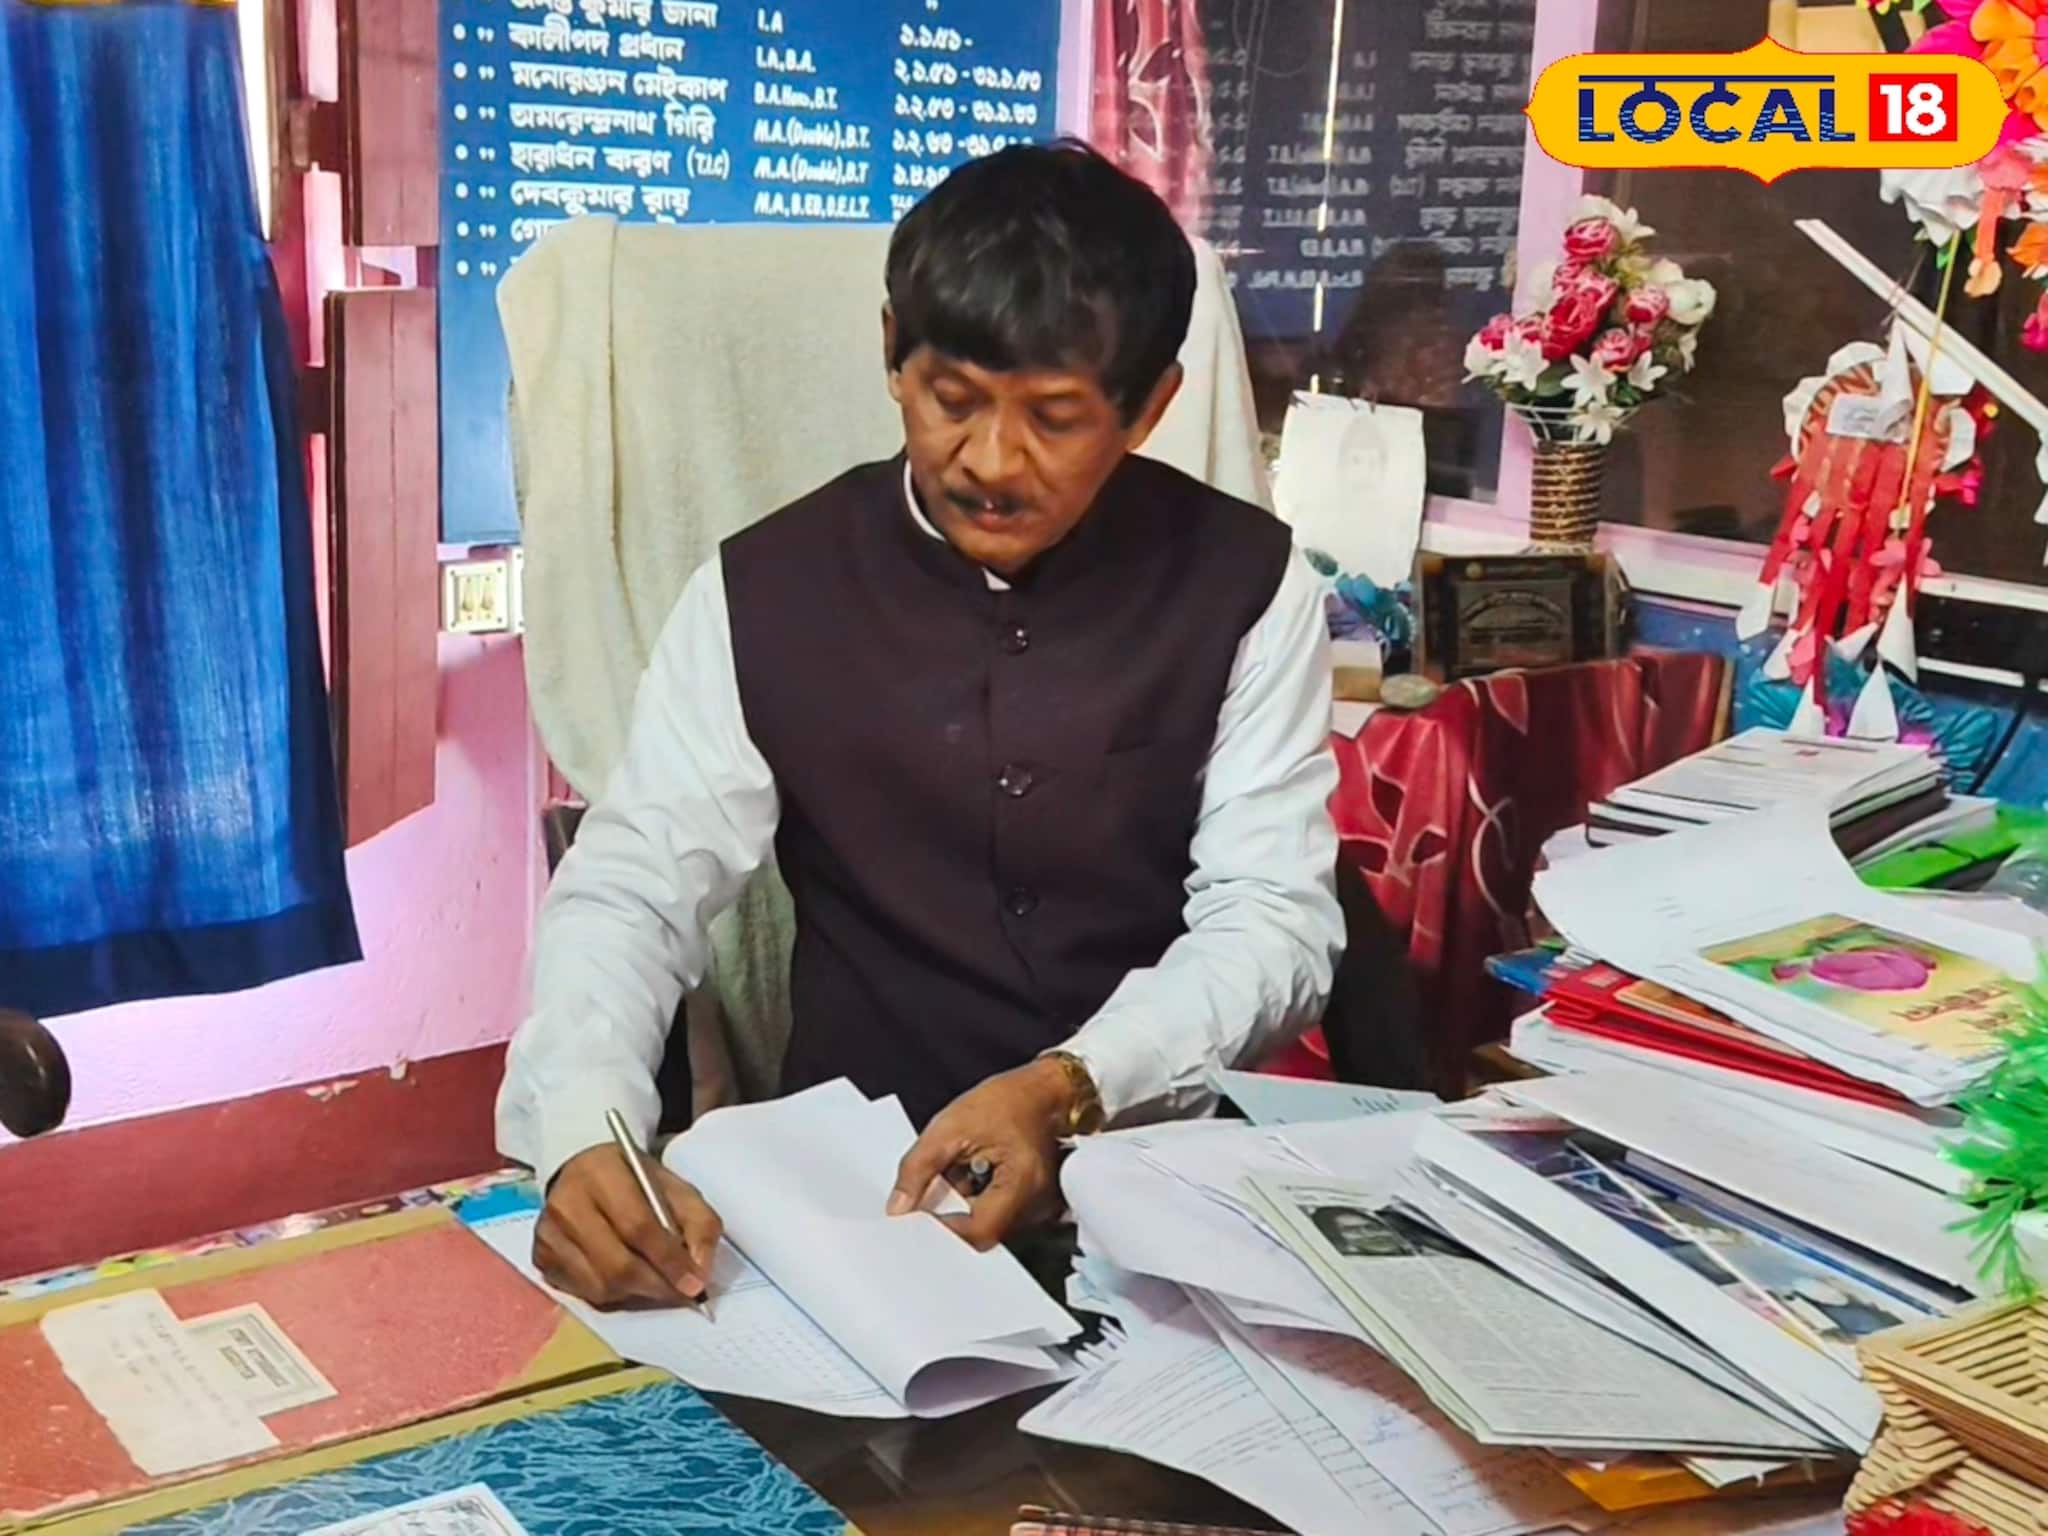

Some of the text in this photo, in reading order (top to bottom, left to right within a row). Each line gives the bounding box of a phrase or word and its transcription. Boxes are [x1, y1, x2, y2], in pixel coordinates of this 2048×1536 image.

[661, 0, 718, 28] জানা
[508, 12, 685, 62] কালীপদ প্রধান
[632, 63, 729, 102] মেইকাপ
[663, 102, 717, 143] গিরি
[509, 141, 597, 173] হারাধন
[602, 147, 672, 179] করণ
[509, 179, 692, 216] দেবকুমার রায়
